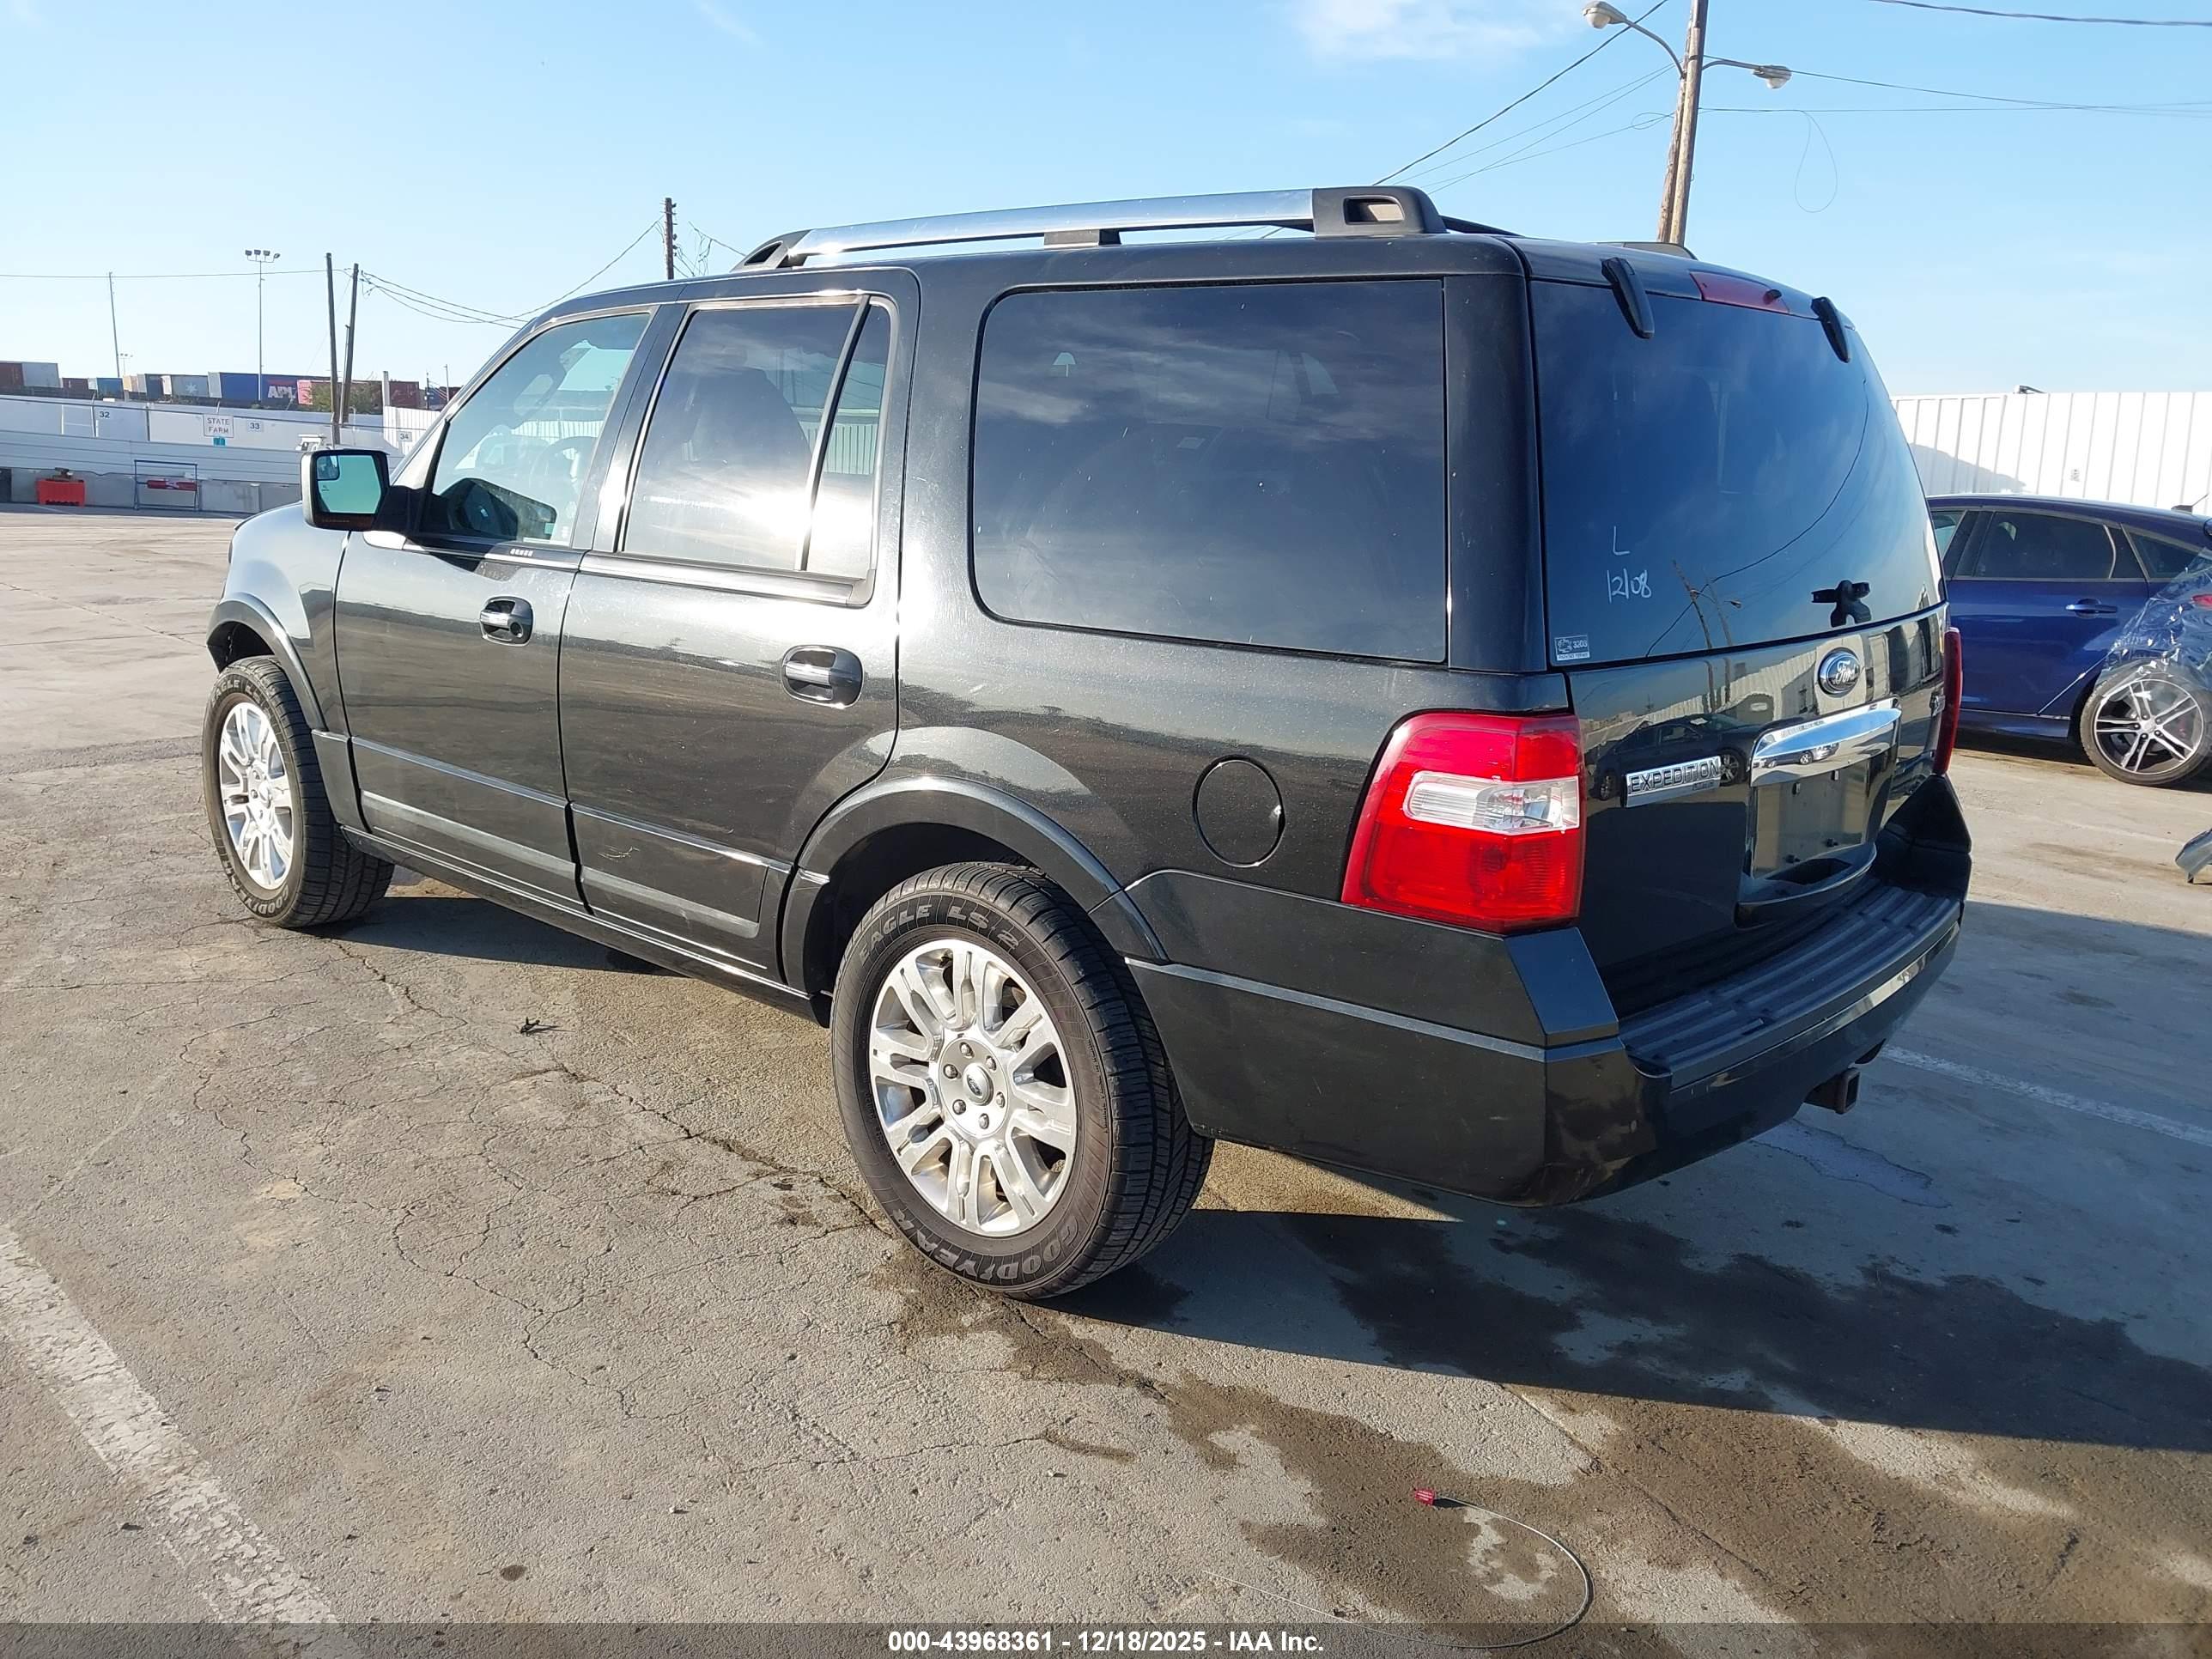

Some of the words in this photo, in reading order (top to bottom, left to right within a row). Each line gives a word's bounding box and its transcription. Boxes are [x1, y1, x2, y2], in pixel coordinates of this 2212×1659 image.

[207, 417, 230, 426] STATE
[1613, 526, 1631, 556] L
[1631, 759, 1720, 791] EXPEDITION
[860, 903, 933, 962] EAGLE
[891, 1209, 1079, 1280] GOODYEAR
